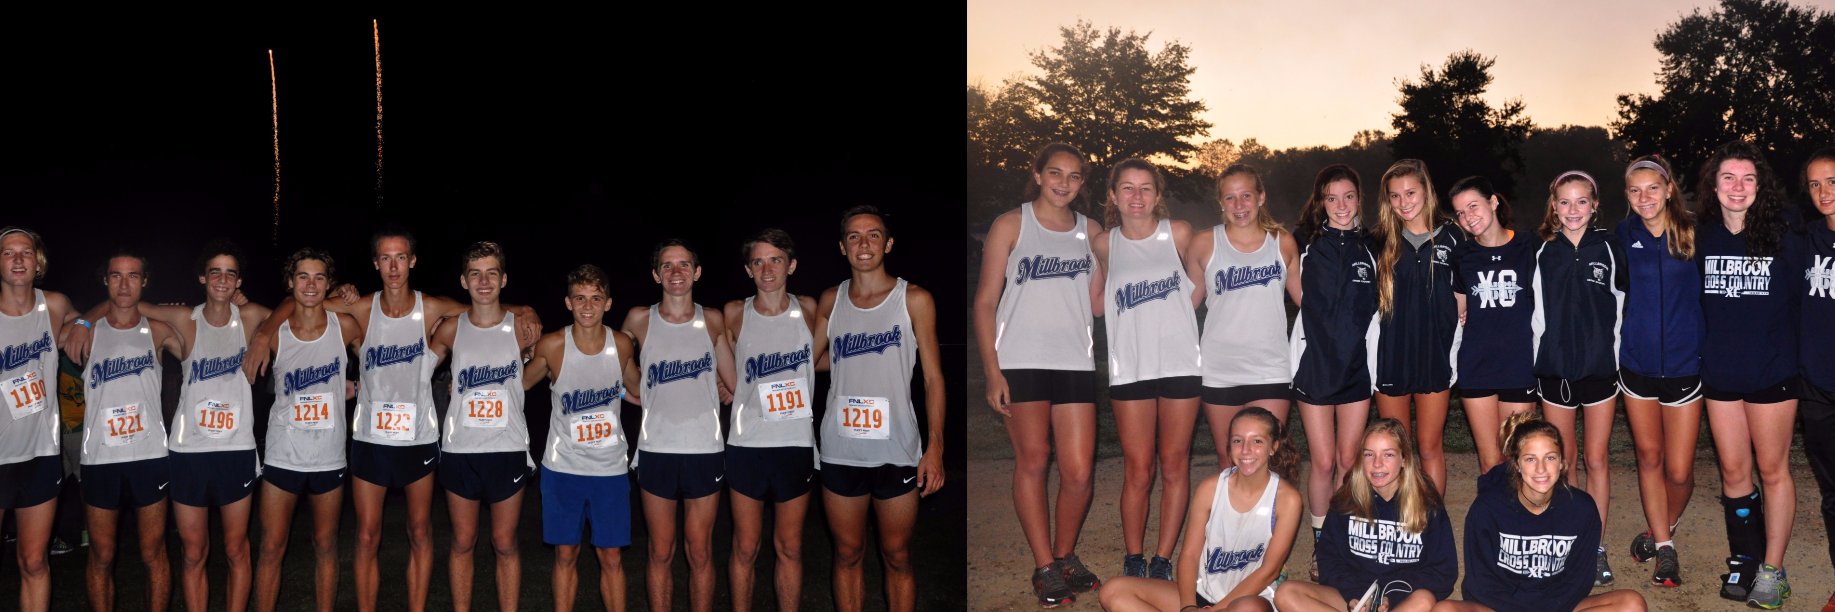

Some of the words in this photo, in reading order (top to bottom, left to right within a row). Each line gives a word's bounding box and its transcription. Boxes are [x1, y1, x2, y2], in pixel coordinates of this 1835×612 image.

[1015, 253, 1092, 286] Millbrook
[1215, 260, 1282, 296] Millbrook
[1728, 276, 1771, 290] COUNTRY
[1115, 270, 1181, 316] Millbrook
[1477, 269, 1518, 308] XC
[0, 331, 52, 374] Millbook
[365, 337, 424, 371] Millbrook
[833, 325, 902, 364] Millbrook
[90, 350, 154, 389] Millbrook
[284, 356, 341, 396] Millbrook
[457, 360, 518, 395] Millbrook
[647, 352, 712, 390] Millbrook
[745, 343, 811, 384] Millbrook
[10, 380, 46, 408] 1190
[468, 400, 503, 418] 1228
[562, 380, 621, 416] Millbrook
[766, 389, 804, 413] 1191
[107, 413, 144, 437] 1221
[199, 407, 234, 430] 1196
[294, 403, 329, 422] 1214
[842, 407, 883, 429] 1219
[577, 421, 612, 442] 1193
[1348, 536, 1377, 554] CROSS
[1499, 549, 1529, 569] CROSS
